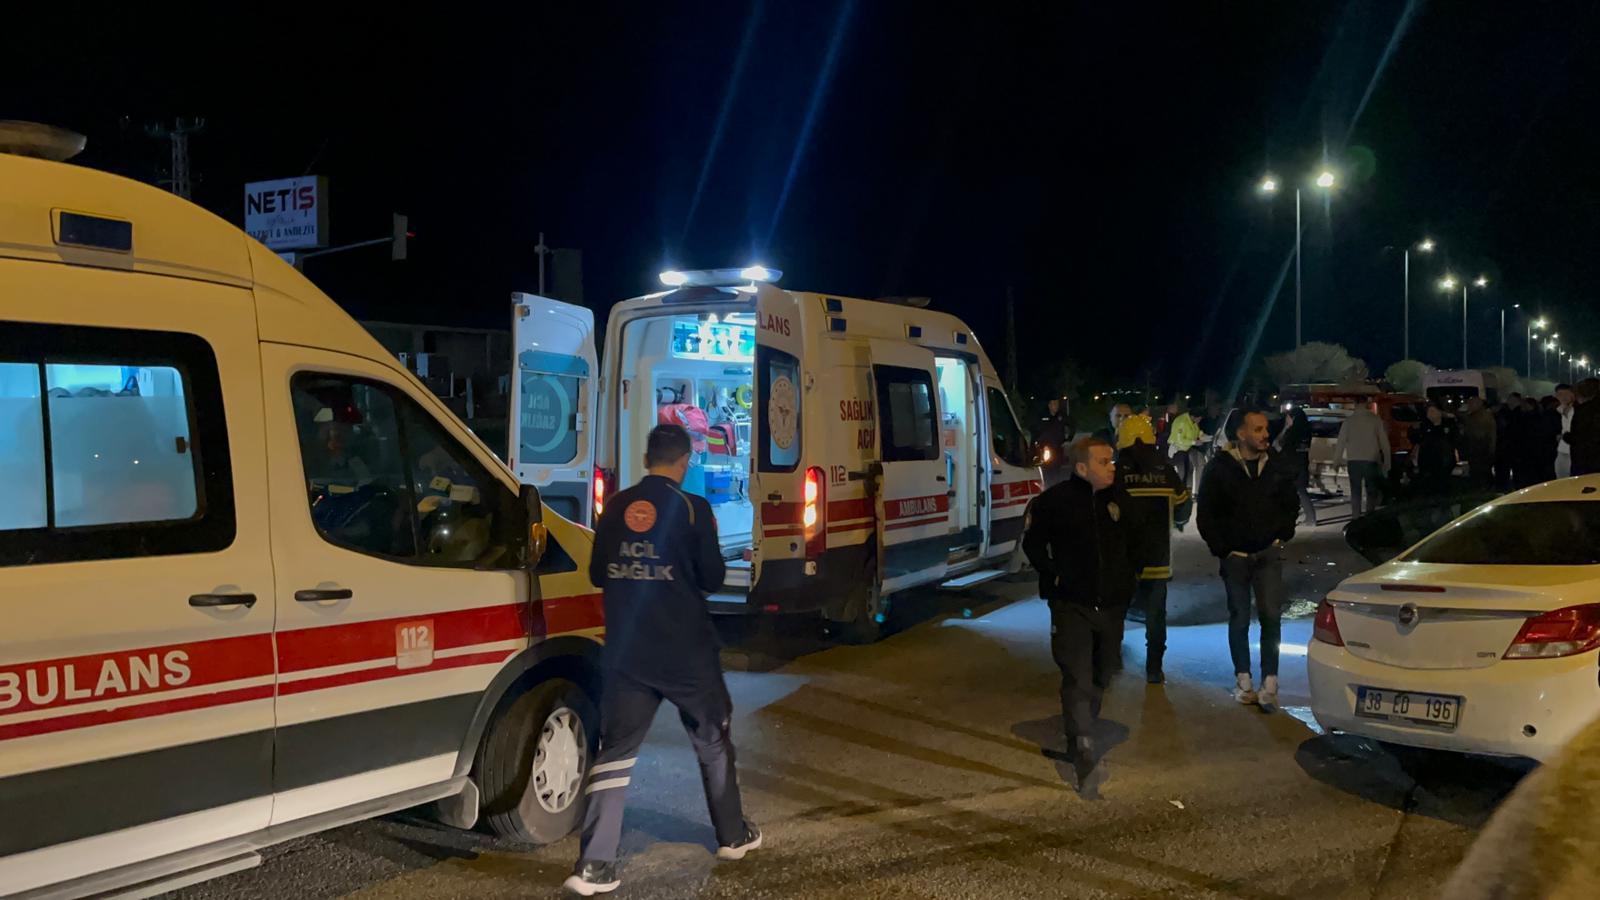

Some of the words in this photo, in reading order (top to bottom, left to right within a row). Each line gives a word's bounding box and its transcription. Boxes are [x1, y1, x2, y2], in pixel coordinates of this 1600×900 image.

[247, 181, 314, 217] NETİŞ
[759, 310, 791, 337] LANS
[839, 396, 874, 421] SAĞLIK
[830, 465, 846, 483] 112
[899, 496, 937, 517] AMBULANS
[619, 540, 660, 559] ACİL
[607, 560, 674, 581] SAĞLIK
[400, 625, 429, 649] 112
[0, 650, 191, 711] BULANS
[1366, 692, 1382, 711] 38
[1392, 695, 1410, 714] ED
[1425, 697, 1452, 720] 196
